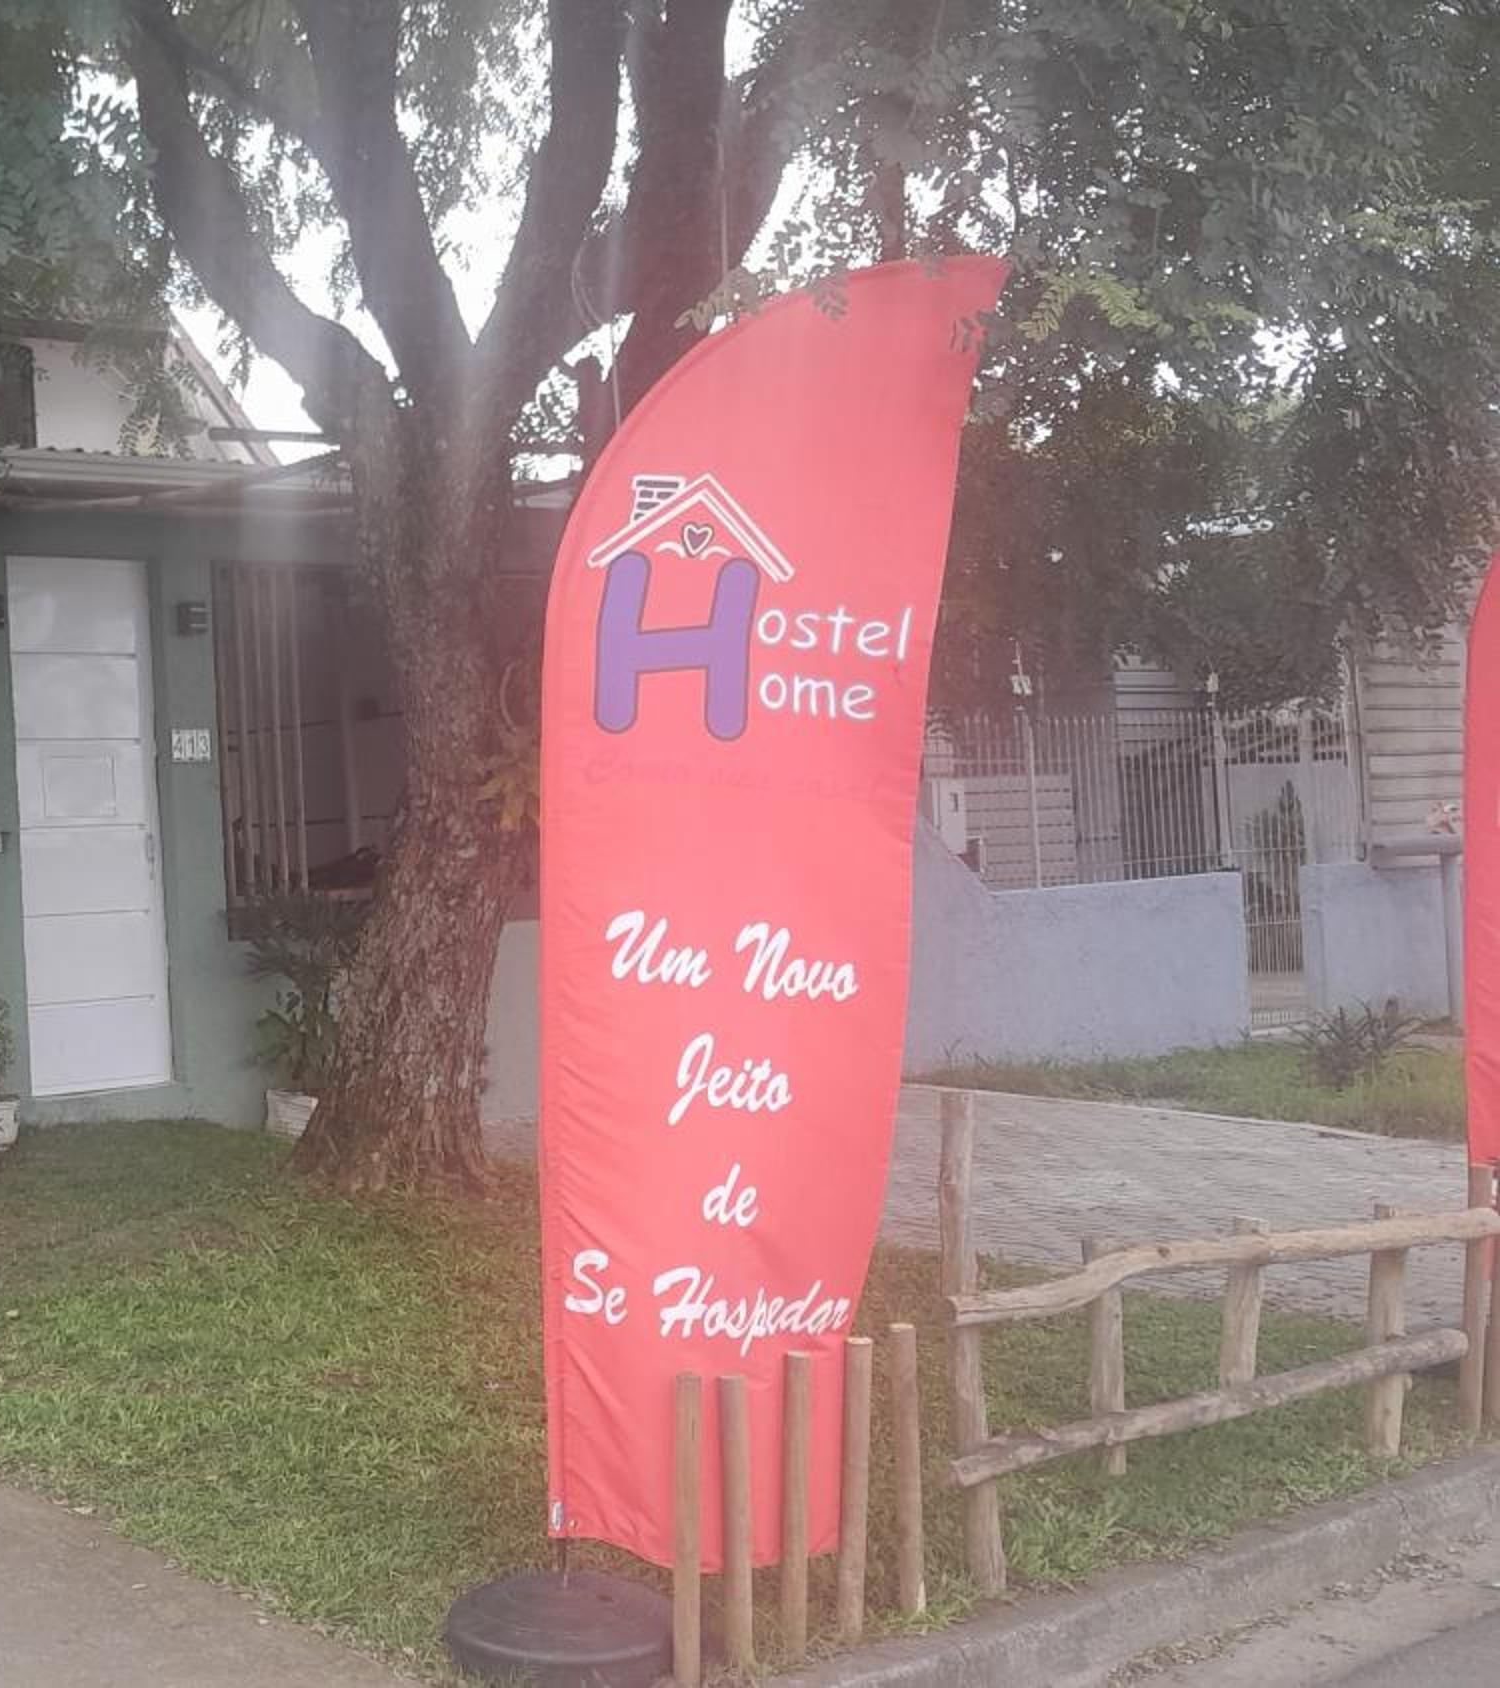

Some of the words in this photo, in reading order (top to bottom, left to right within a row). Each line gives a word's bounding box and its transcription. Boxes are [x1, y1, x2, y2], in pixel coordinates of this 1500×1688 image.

[172, 733, 210, 756] 413
[605, 910, 711, 988] Um
[735, 922, 859, 1001] Novo
[668, 1032, 792, 1126] Jeito
[703, 1163, 757, 1226] de
[565, 1249, 627, 1325] Se
[653, 1266, 850, 1356] Hospedar
